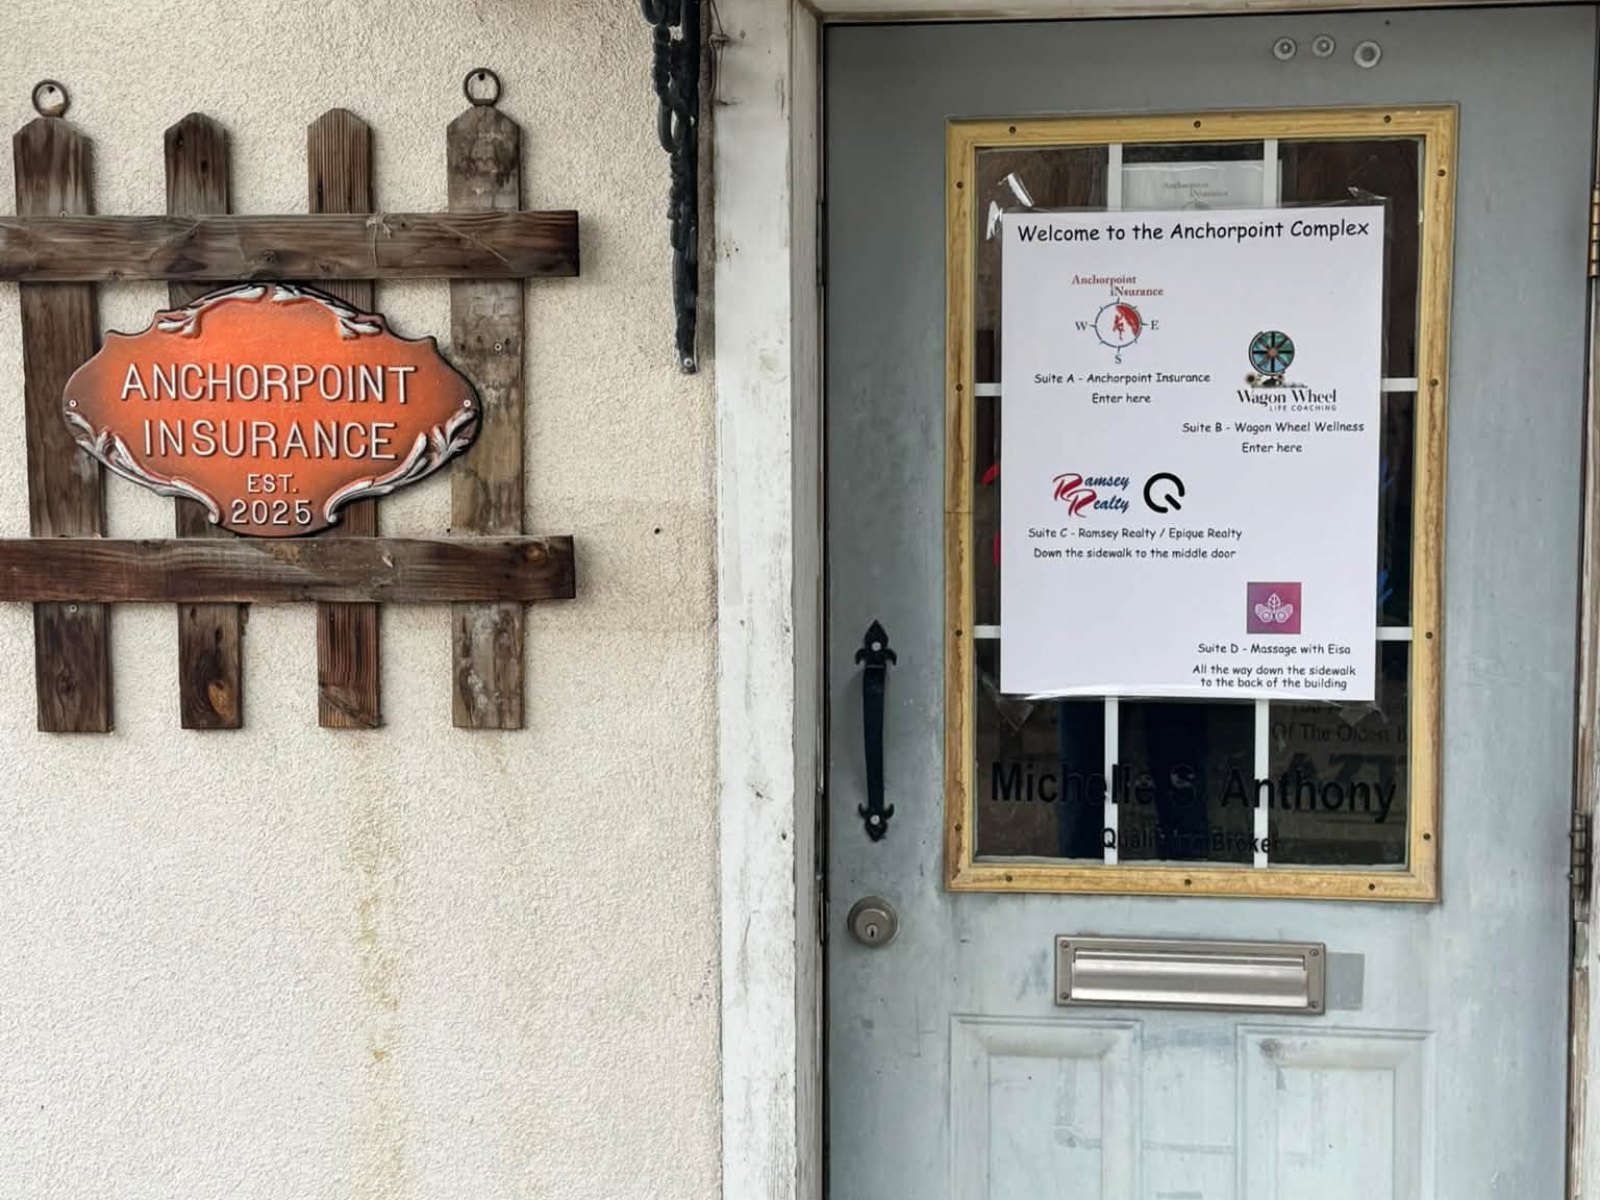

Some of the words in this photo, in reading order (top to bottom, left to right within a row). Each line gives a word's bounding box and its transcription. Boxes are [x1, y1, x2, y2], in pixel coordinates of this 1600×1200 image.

[1017, 223, 1101, 243] Welcome
[1105, 224, 1126, 241] to
[1131, 222, 1164, 240] the
[1170, 221, 1285, 244] Anchorpoint
[1290, 218, 1370, 241] Complex
[1071, 274, 1137, 288] Anchorpoint
[1074, 320, 1089, 331] W
[1150, 319, 1159, 331] E
[1114, 353, 1122, 365] S
[120, 362, 415, 403] ANCHORPOINT
[1034, 373, 1063, 384] Suite
[1066, 373, 1075, 384] A
[1086, 373, 1153, 386] Anchorpoint
[1155, 372, 1211, 383] Insurance
[1091, 392, 1123, 404] Enter
[1125, 392, 1152, 404] here
[1236, 387, 1287, 407] Wagon
[1291, 388, 1337, 404] Wheel
[1269, 404, 1288, 412] LIFE
[1290, 404, 1337, 412] COACHING
[1182, 422, 1212, 433] Suite
[1214, 421, 1223, 433] B
[1234, 422, 1272, 436] Wagon
[1274, 421, 1311, 433] Wheel
[1314, 421, 1365, 432] Wellness
[143, 418, 398, 461] INSURANCE
[1241, 441, 1274, 454] Enter
[1276, 442, 1303, 453] here
[247, 473, 299, 494] EST.
[1052, 472, 1130, 502] Ramsey
[1064, 488, 1130, 518] Realty
[230, 499, 312, 525] 2025
[1028, 527, 1057, 538] Suite
[1059, 527, 1068, 538] C
[1078, 527, 1119, 541] Ramsey
[1121, 527, 1157, 541] Realty
[1168, 527, 1205, 541] Epique
[1207, 527, 1243, 541] Realty
[1033, 547, 1063, 559] Down
[1064, 547, 1084, 558] the
[1086, 547, 1133, 558] sidewalk
[1134, 549, 1147, 559] to
[1149, 548, 1169, 558] the
[1171, 547, 1208, 559] middle
[1210, 548, 1237, 559] door
[1197, 642, 1227, 654] Suite
[1230, 642, 1240, 655] D
[1250, 643, 1297, 657] Massage
[1299, 643, 1325, 655] with
[1192, 663, 1207, 674] All
[1210, 663, 1230, 675] the
[1232, 666, 1253, 678] way
[1255, 665, 1284, 675] down
[1286, 664, 1306, 676] the
[1308, 665, 1357, 676] sidewalk
[1200, 677, 1213, 687] to
[1215, 677, 1234, 688] the
[1237, 677, 1264, 688] back
[1265, 677, 1278, 688] of
[1281, 677, 1301, 689] the
[1303, 677, 1348, 692] building
[1220, 767, 1396, 823] Anthony
